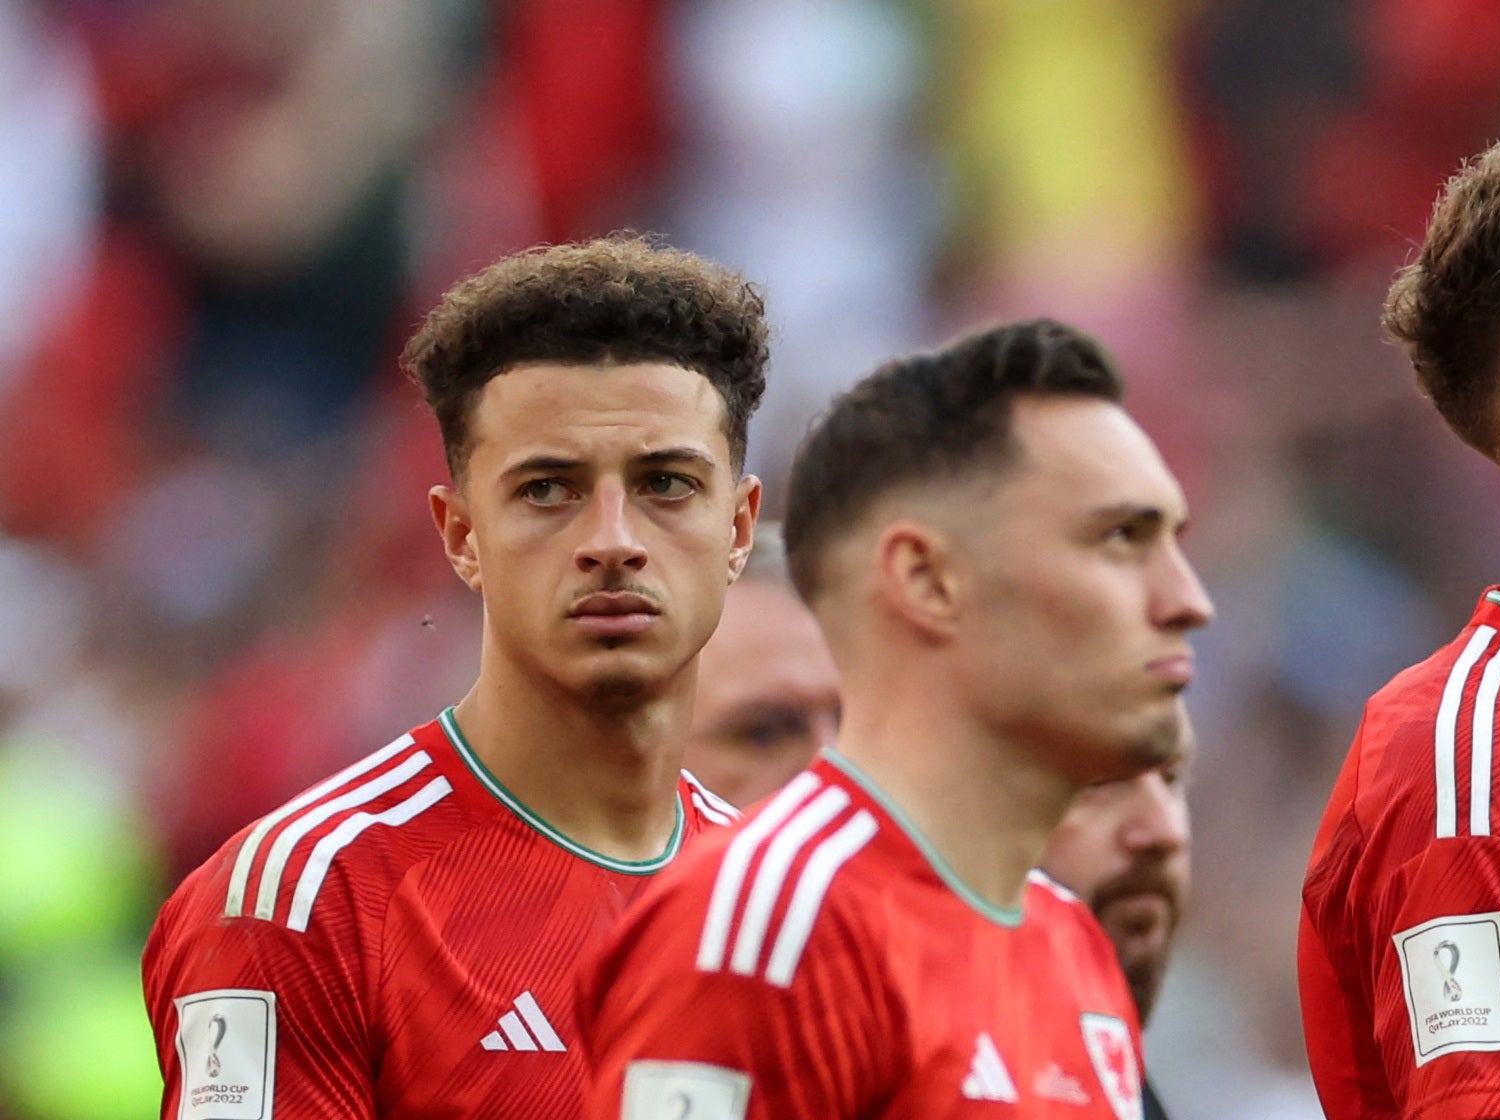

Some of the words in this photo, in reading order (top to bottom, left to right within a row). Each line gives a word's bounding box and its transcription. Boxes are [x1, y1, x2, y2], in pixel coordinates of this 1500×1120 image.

[1439, 1008, 1473, 1019] WORLD
[1474, 1007, 1492, 1016] CUP
[230, 1084, 249, 1094] CUP
